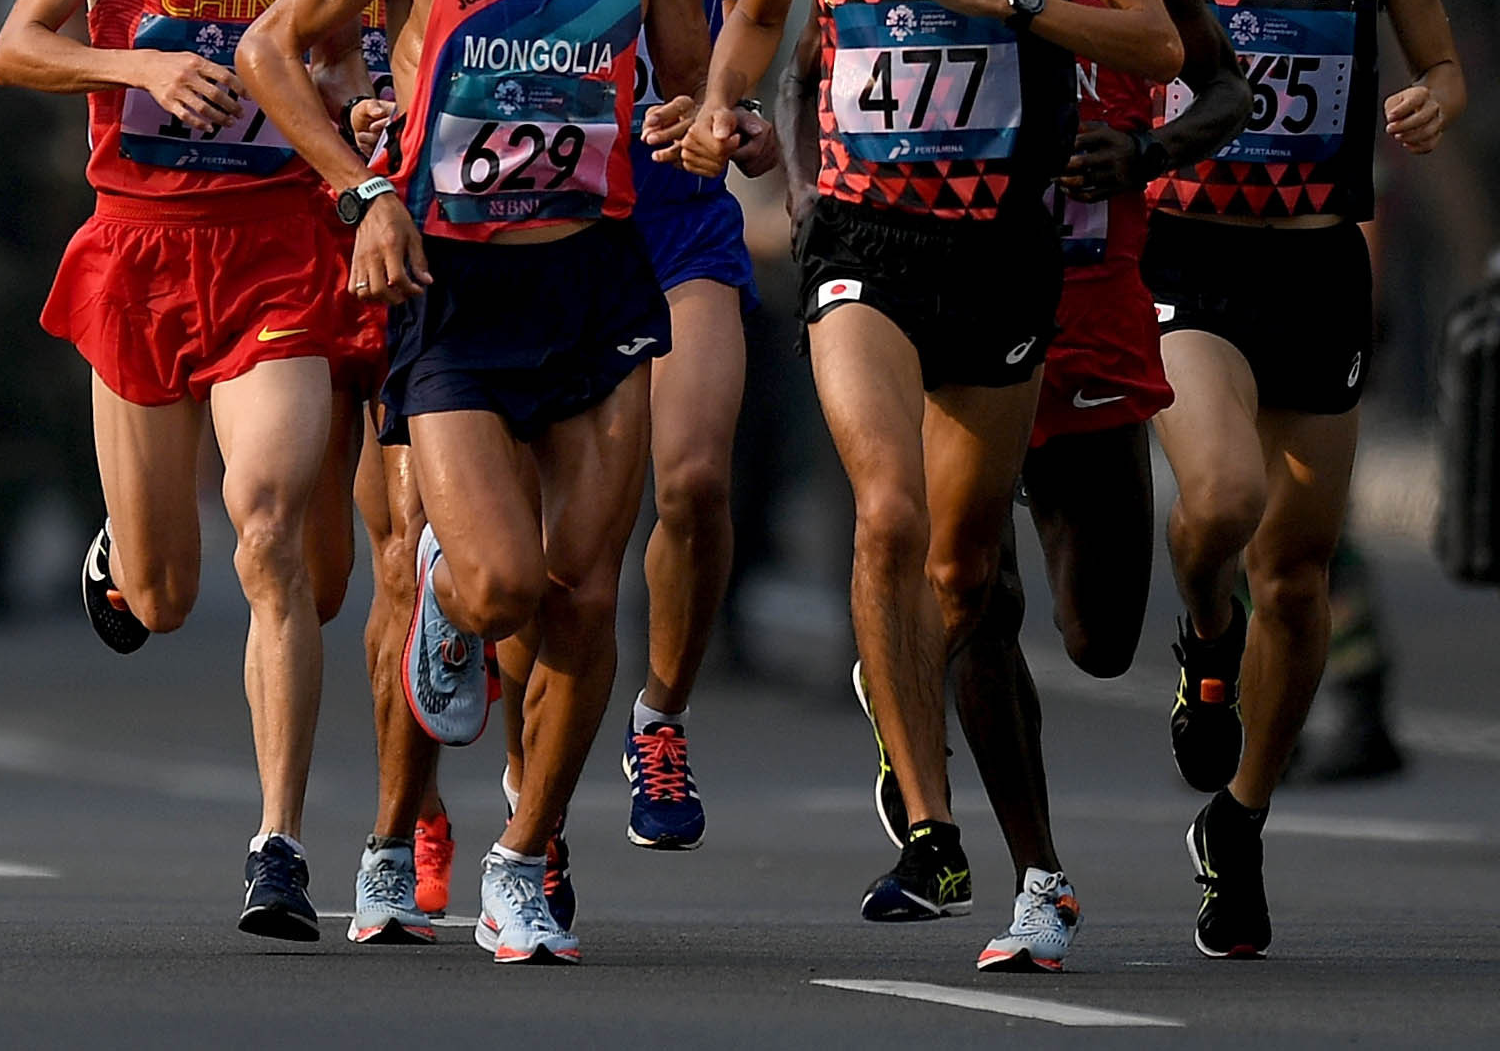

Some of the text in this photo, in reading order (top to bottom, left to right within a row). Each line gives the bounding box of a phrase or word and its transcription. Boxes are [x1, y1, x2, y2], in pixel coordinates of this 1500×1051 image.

[463, 35, 613, 74] MONGOLIA
[858, 48, 987, 130] 477
[1242, 55, 1321, 134] 65
[460, 122, 587, 194] 629
